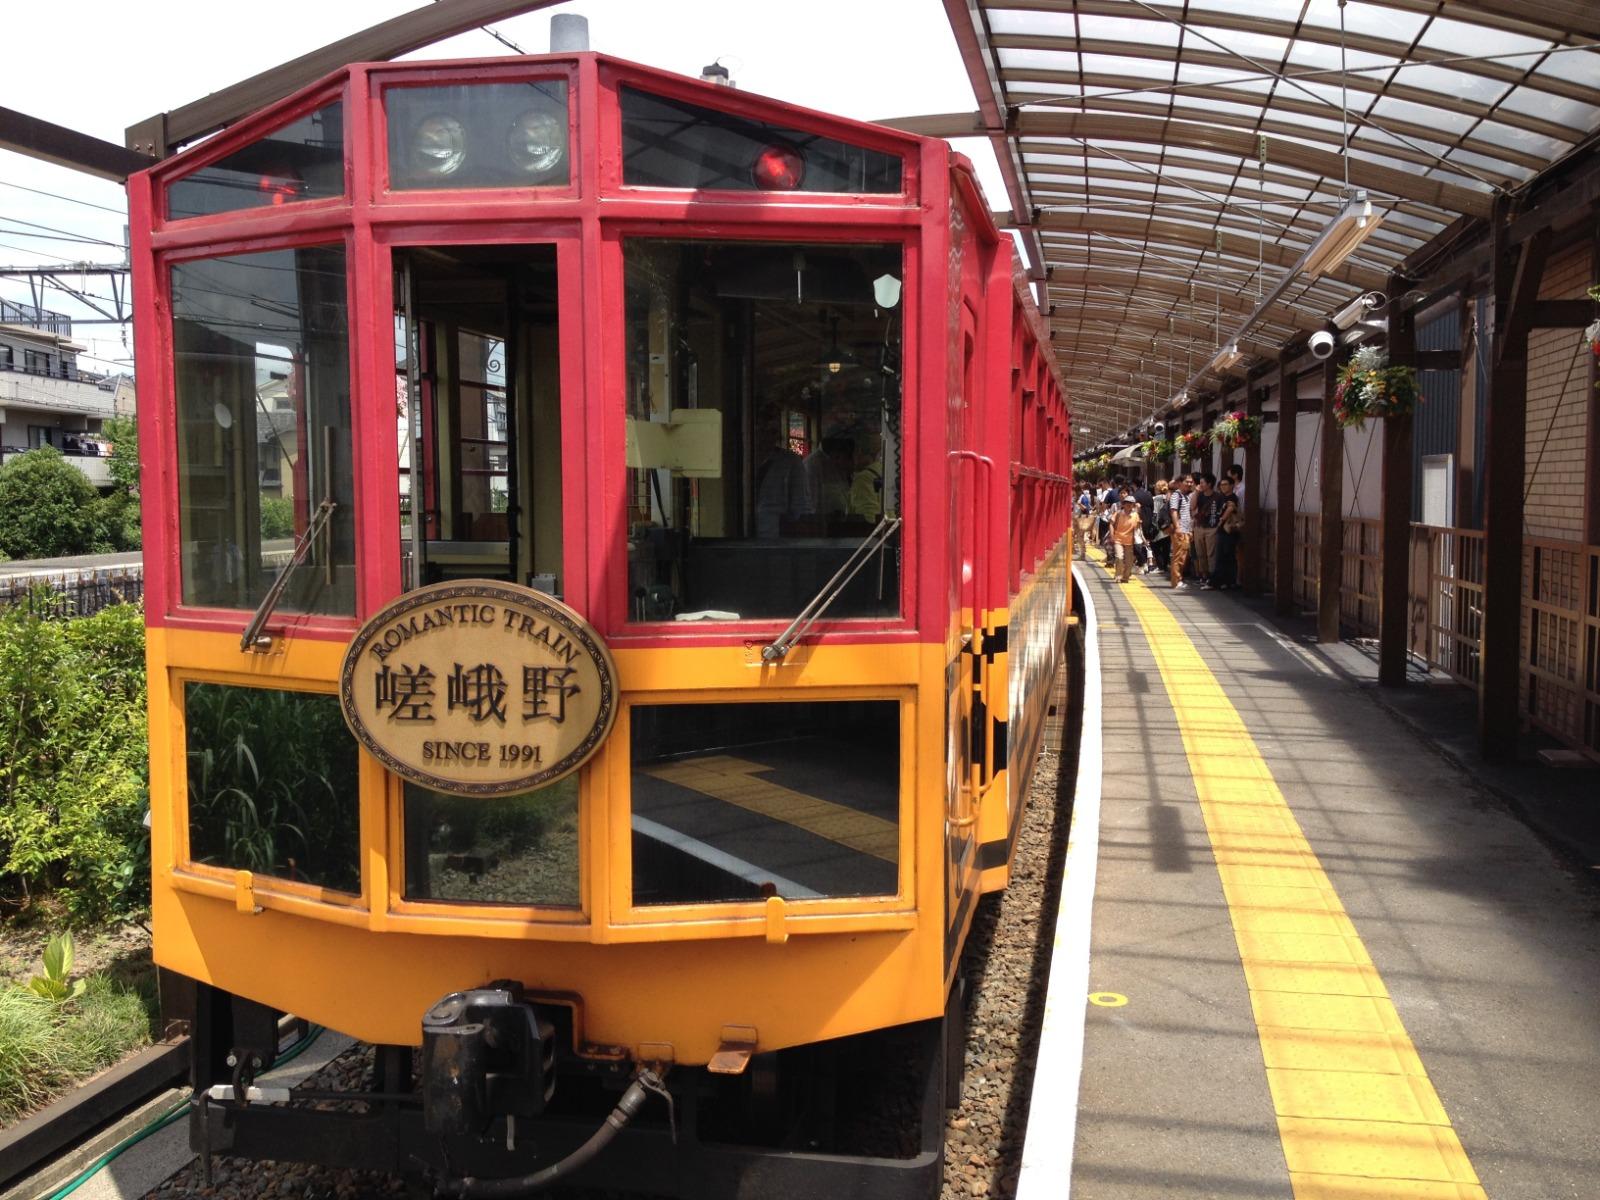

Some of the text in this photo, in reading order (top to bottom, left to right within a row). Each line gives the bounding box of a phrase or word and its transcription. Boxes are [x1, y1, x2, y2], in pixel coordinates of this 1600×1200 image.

[370, 604, 581, 664] ROMANTIC TRAIN
[375, 662, 581, 725] 嵯峨野
[423, 741, 542, 763] SINCE 1991
